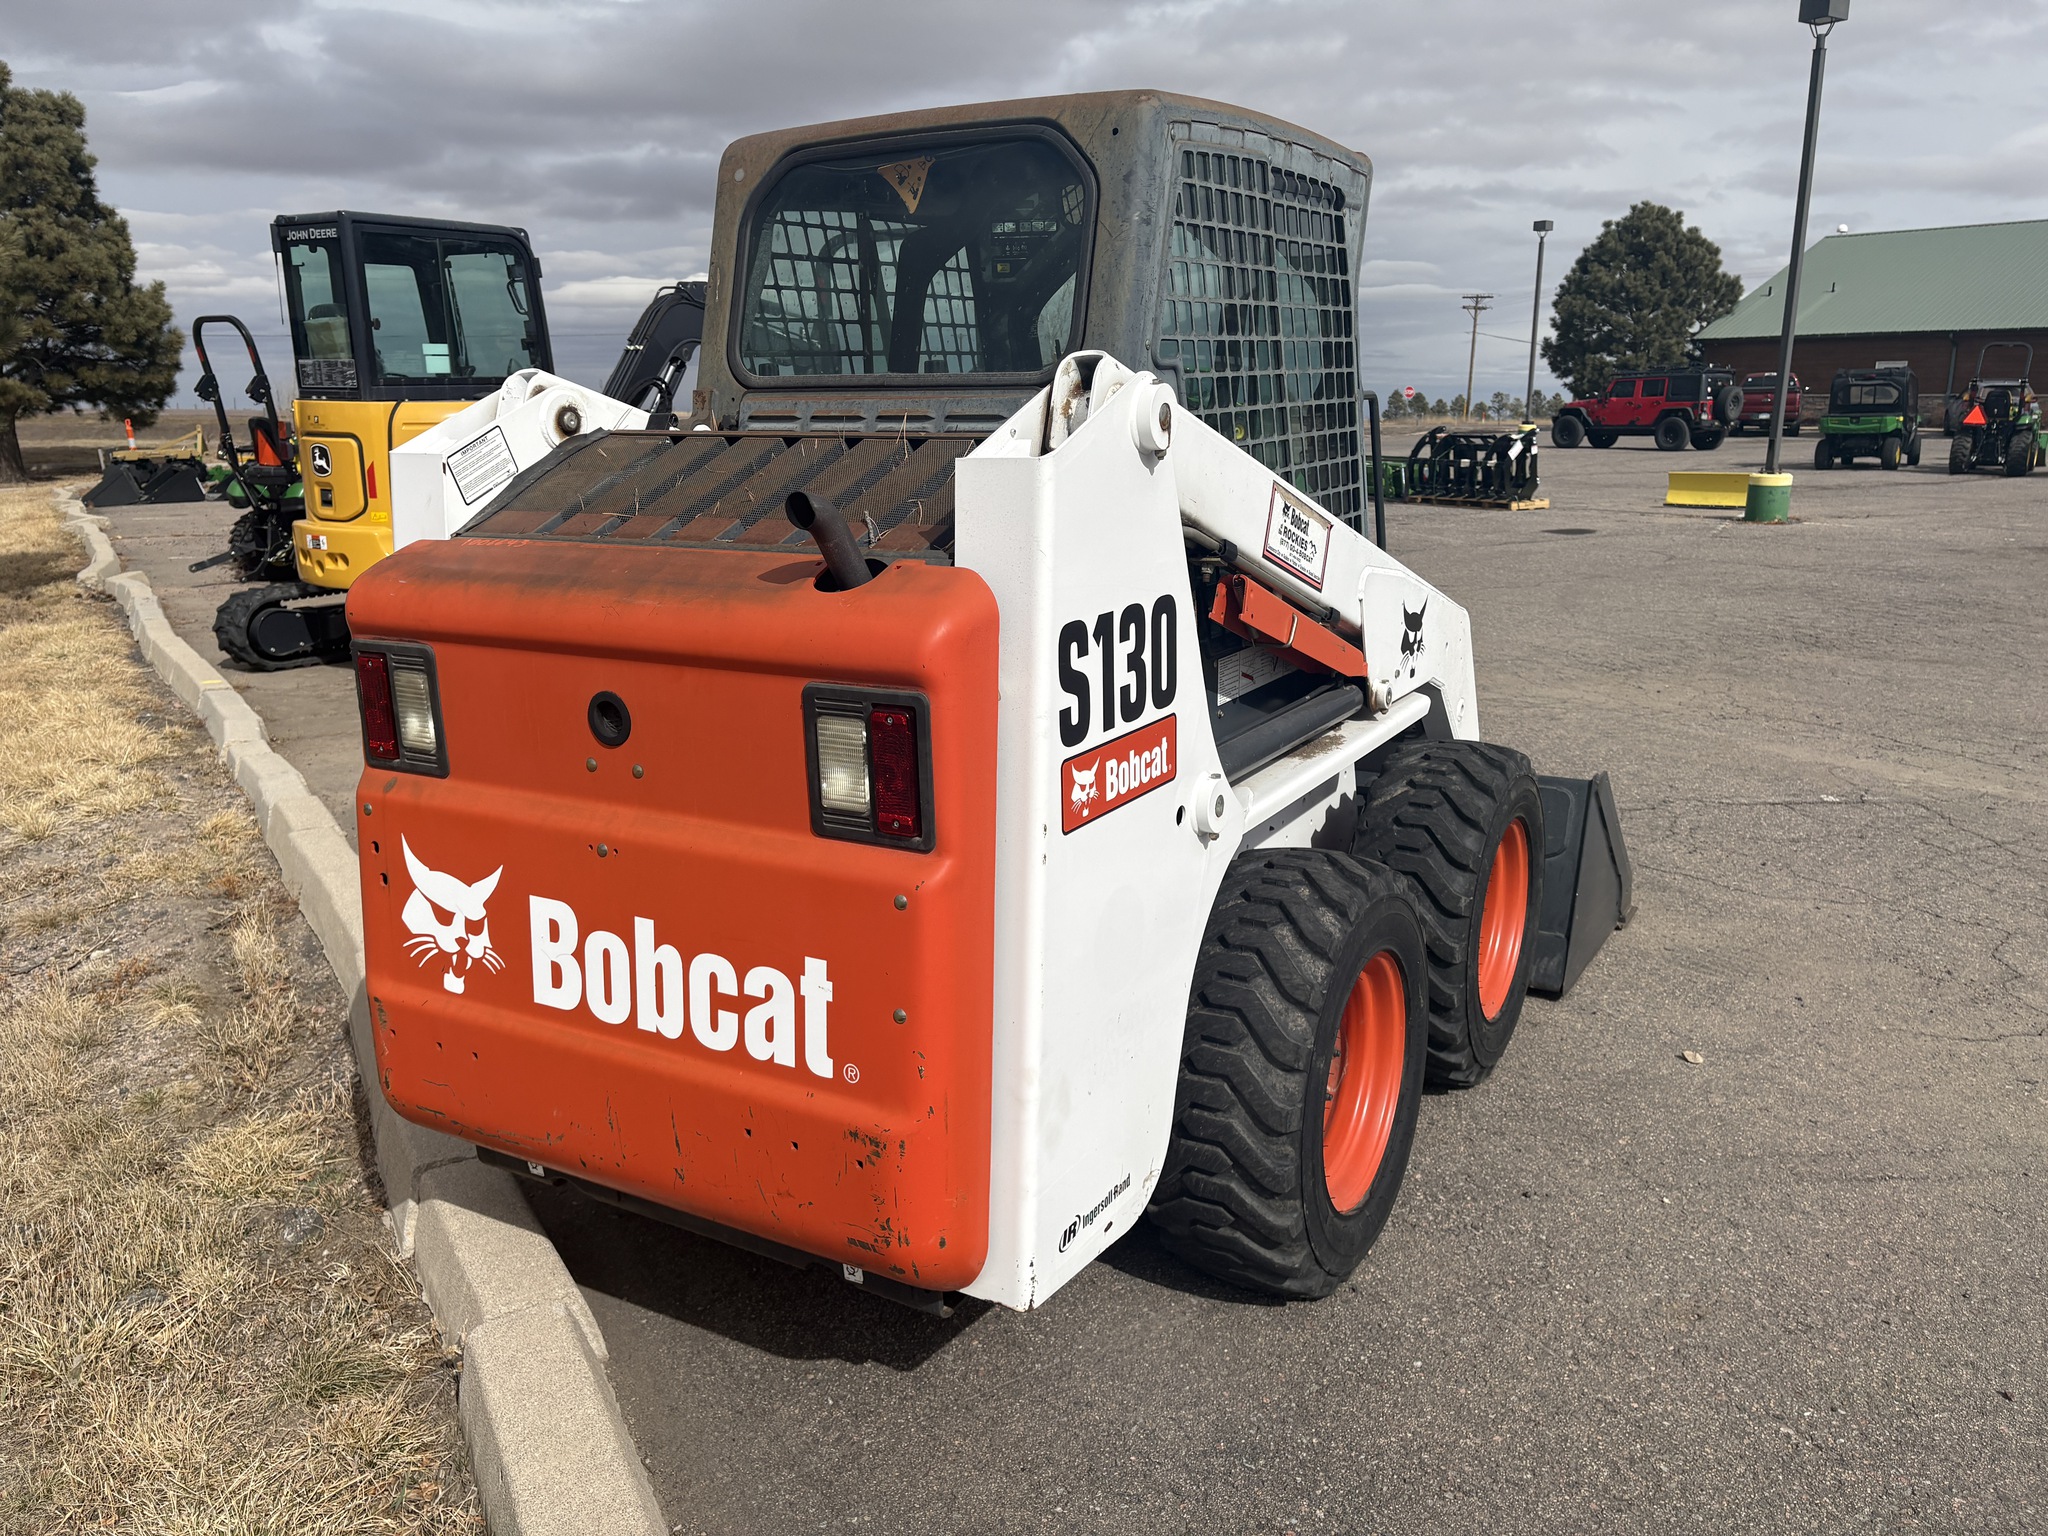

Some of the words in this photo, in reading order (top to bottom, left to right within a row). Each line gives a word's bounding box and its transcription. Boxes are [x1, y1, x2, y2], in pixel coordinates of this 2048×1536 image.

[287, 229, 309, 241] JOHN
[309, 227, 338, 239] DEERE
[460, 436, 489, 456] IMPORTANT
[1290, 508, 1310, 537] Bobcat
[1283, 526, 1308, 551] ROCKIES
[1058, 593, 1178, 748] S130
[1105, 736, 1169, 803] Bobcat
[528, 894, 834, 1080] Bobcat
